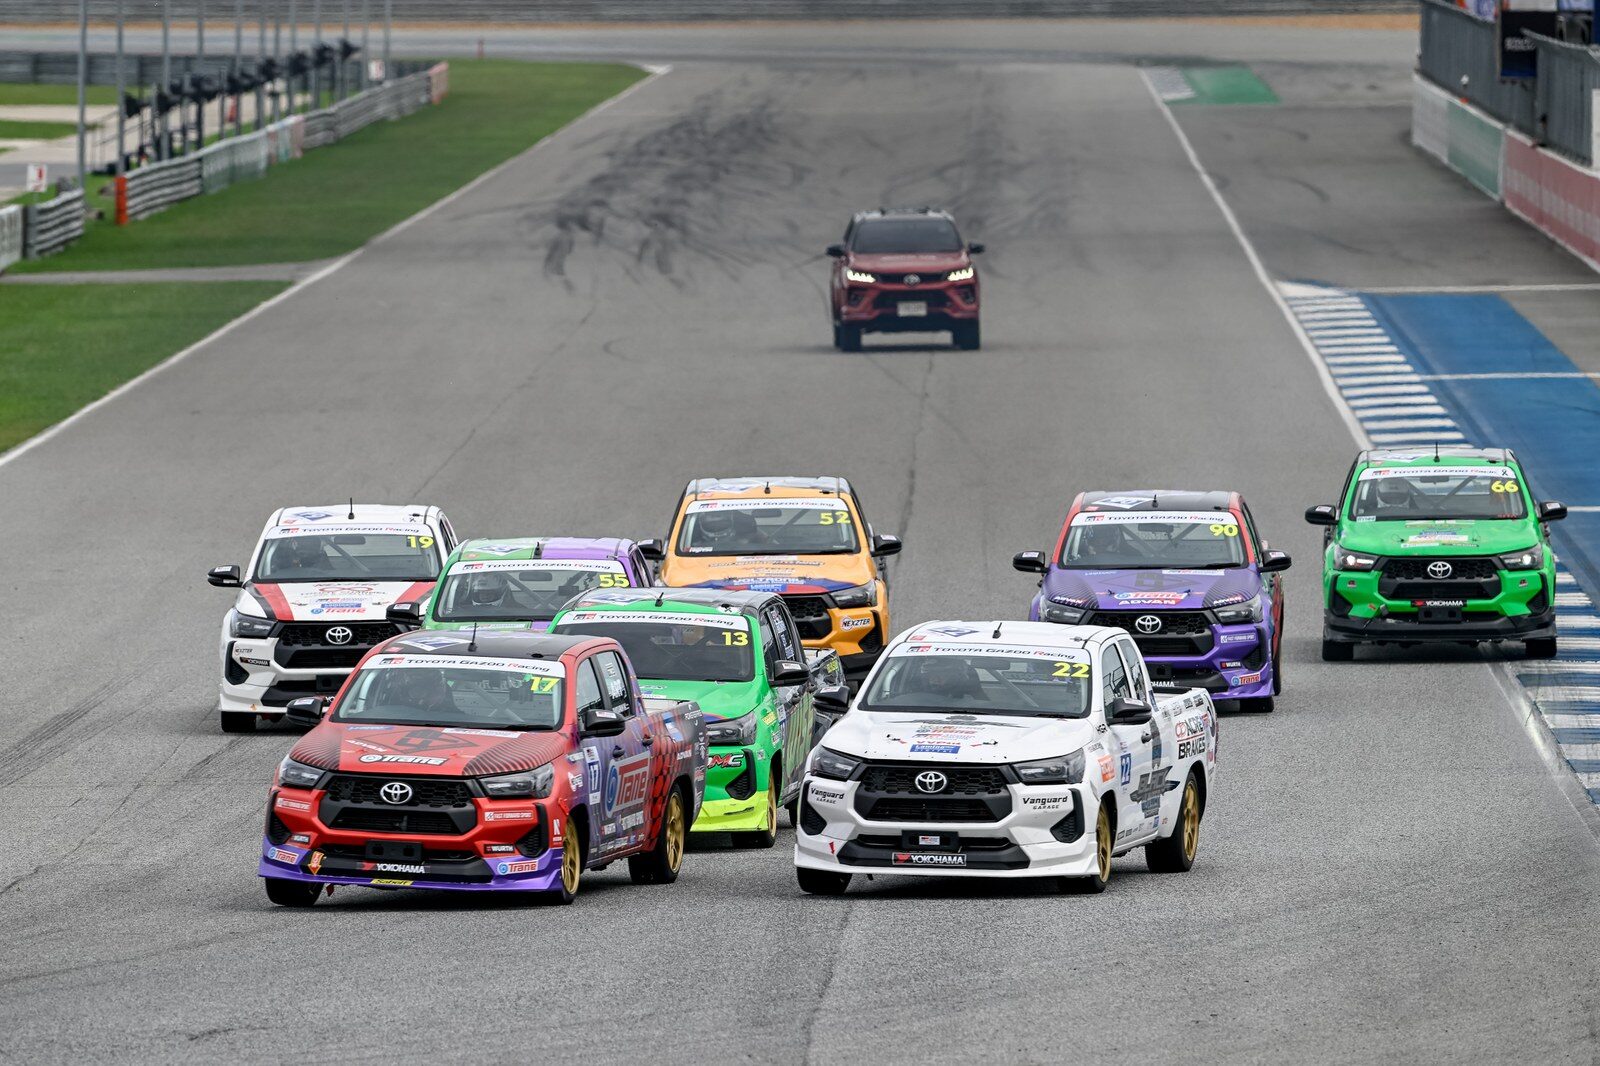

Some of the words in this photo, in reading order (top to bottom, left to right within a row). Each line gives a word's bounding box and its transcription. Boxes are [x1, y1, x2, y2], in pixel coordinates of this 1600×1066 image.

[1491, 480, 1519, 494] 66
[819, 510, 851, 526] 52
[1190, 515, 1225, 523] Racing
[1209, 524, 1239, 538] 90
[406, 536, 434, 549] 19
[599, 574, 630, 588] 55
[694, 617, 734, 626] Racing
[842, 618, 870, 627] NEXZTER
[722, 632, 749, 646] 13
[1033, 650, 1076, 660] Racing
[507, 662, 550, 673] Racing
[1052, 662, 1090, 678] 22
[530, 676, 560, 692] 17
[1178, 737, 1206, 760] BRAKES
[590, 764, 599, 791] 17
[616, 757, 649, 807] Trane
[811, 787, 845, 800] Vanguard
[1023, 795, 1069, 806] Vanguard
[275, 850, 297, 864] Trane
[911, 855, 965, 866] YOKOHAMA
[376, 862, 425, 874] YOKOHAMA
[508, 861, 537, 873] Trane
